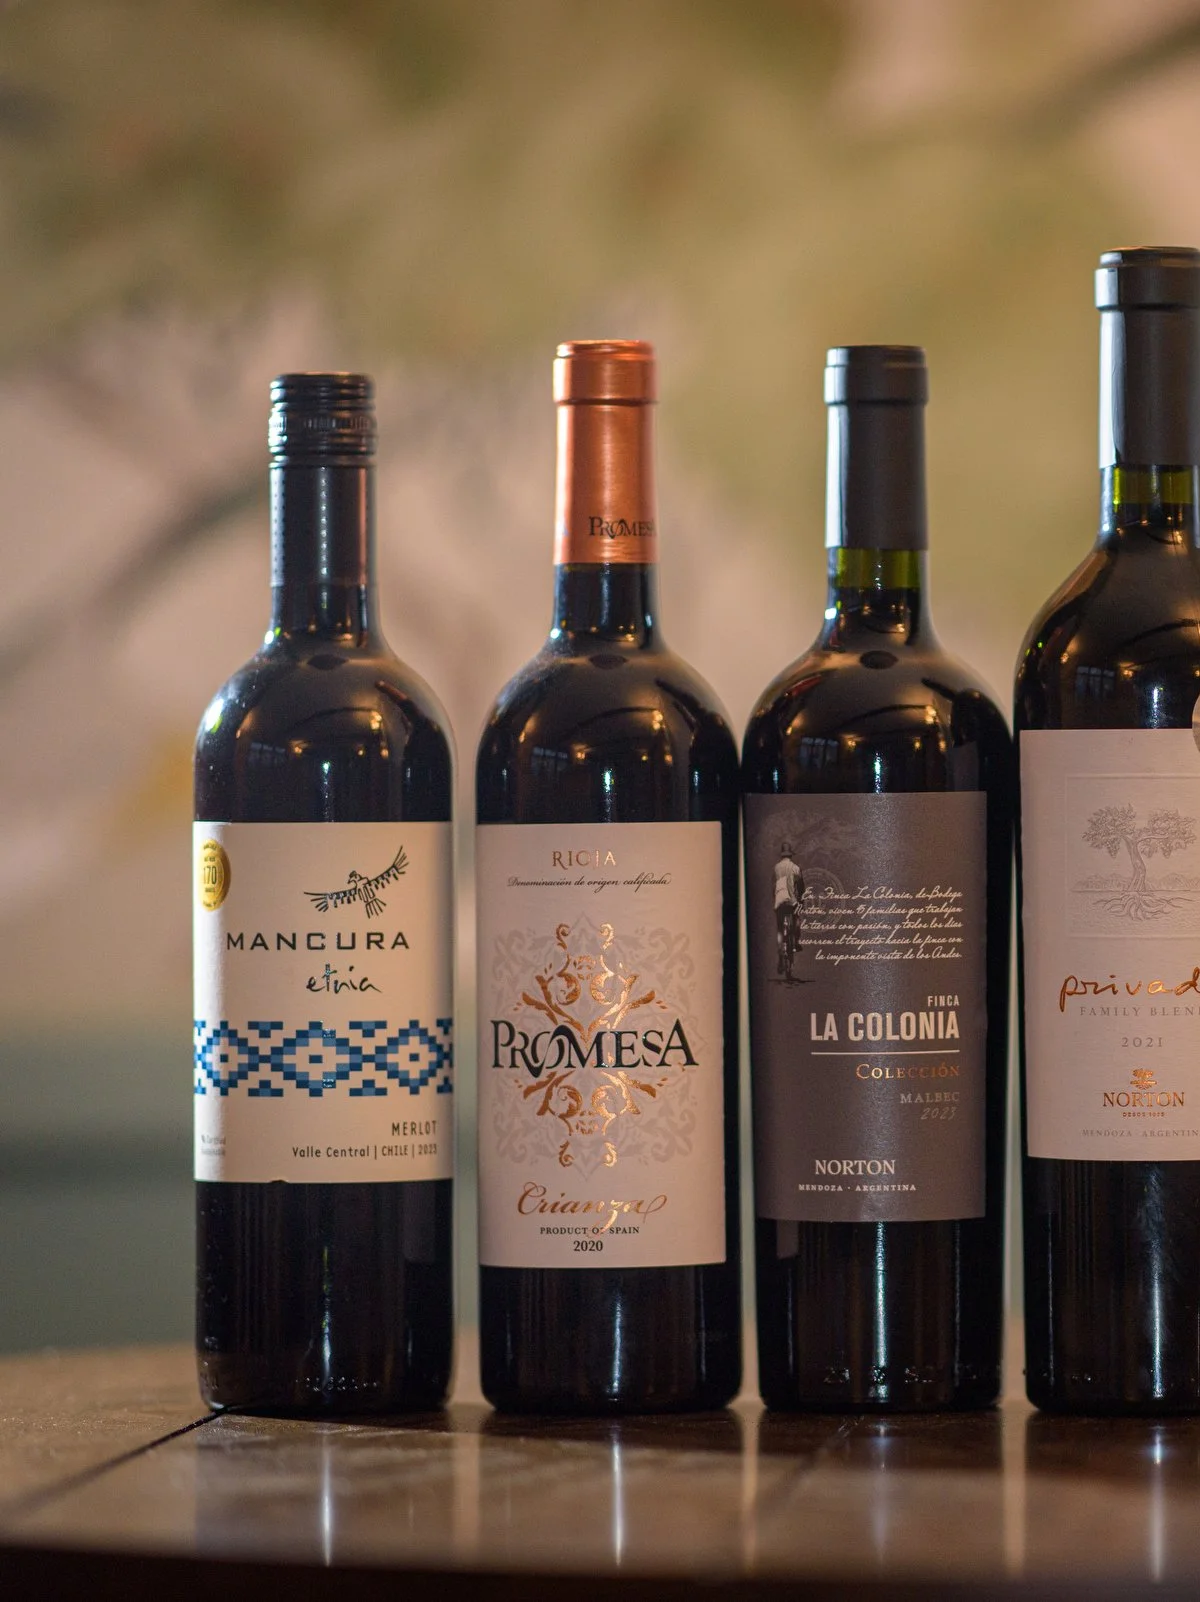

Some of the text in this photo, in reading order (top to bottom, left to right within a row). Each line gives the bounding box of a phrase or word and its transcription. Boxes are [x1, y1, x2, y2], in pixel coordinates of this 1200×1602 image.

[574, 875, 585, 886] de
[587, 877, 619, 893] origen
[623, 871, 672, 893] calificada
[852, 885, 872, 900] La
[929, 917, 943, 929] los
[227, 932, 410, 950] MANCURA
[903, 948, 916, 959] de
[916, 947, 931, 959] los
[927, 995, 960, 1007] FINCA
[1080, 1006, 1141, 1017] FAMILY
[811, 1010, 960, 1041] LA COLONIA
[489, 1018, 700, 1079] PROMESA
[1121, 1037, 1163, 1048] 2021
[900, 1092, 960, 1104] MALBEC
[1102, 1091, 1185, 1108] NORTON
[921, 1106, 957, 1120] 2023
[392, 1120, 437, 1136] MERLOT
[1082, 1129, 1132, 1138] MENDOZA
[292, 1146, 321, 1158] Valle
[326, 1145, 370, 1158] Central
[381, 1145, 409, 1157] CHILE
[815, 1159, 896, 1176] NORTON
[798, 1184, 917, 1192] MENDOZA ARGENTINA
[517, 1181, 668, 1238] Crianza
[540, 1226, 588, 1235] PRODUCT
[609, 1226, 640, 1235] SPAIN
[573, 1239, 604, 1252] 2020
